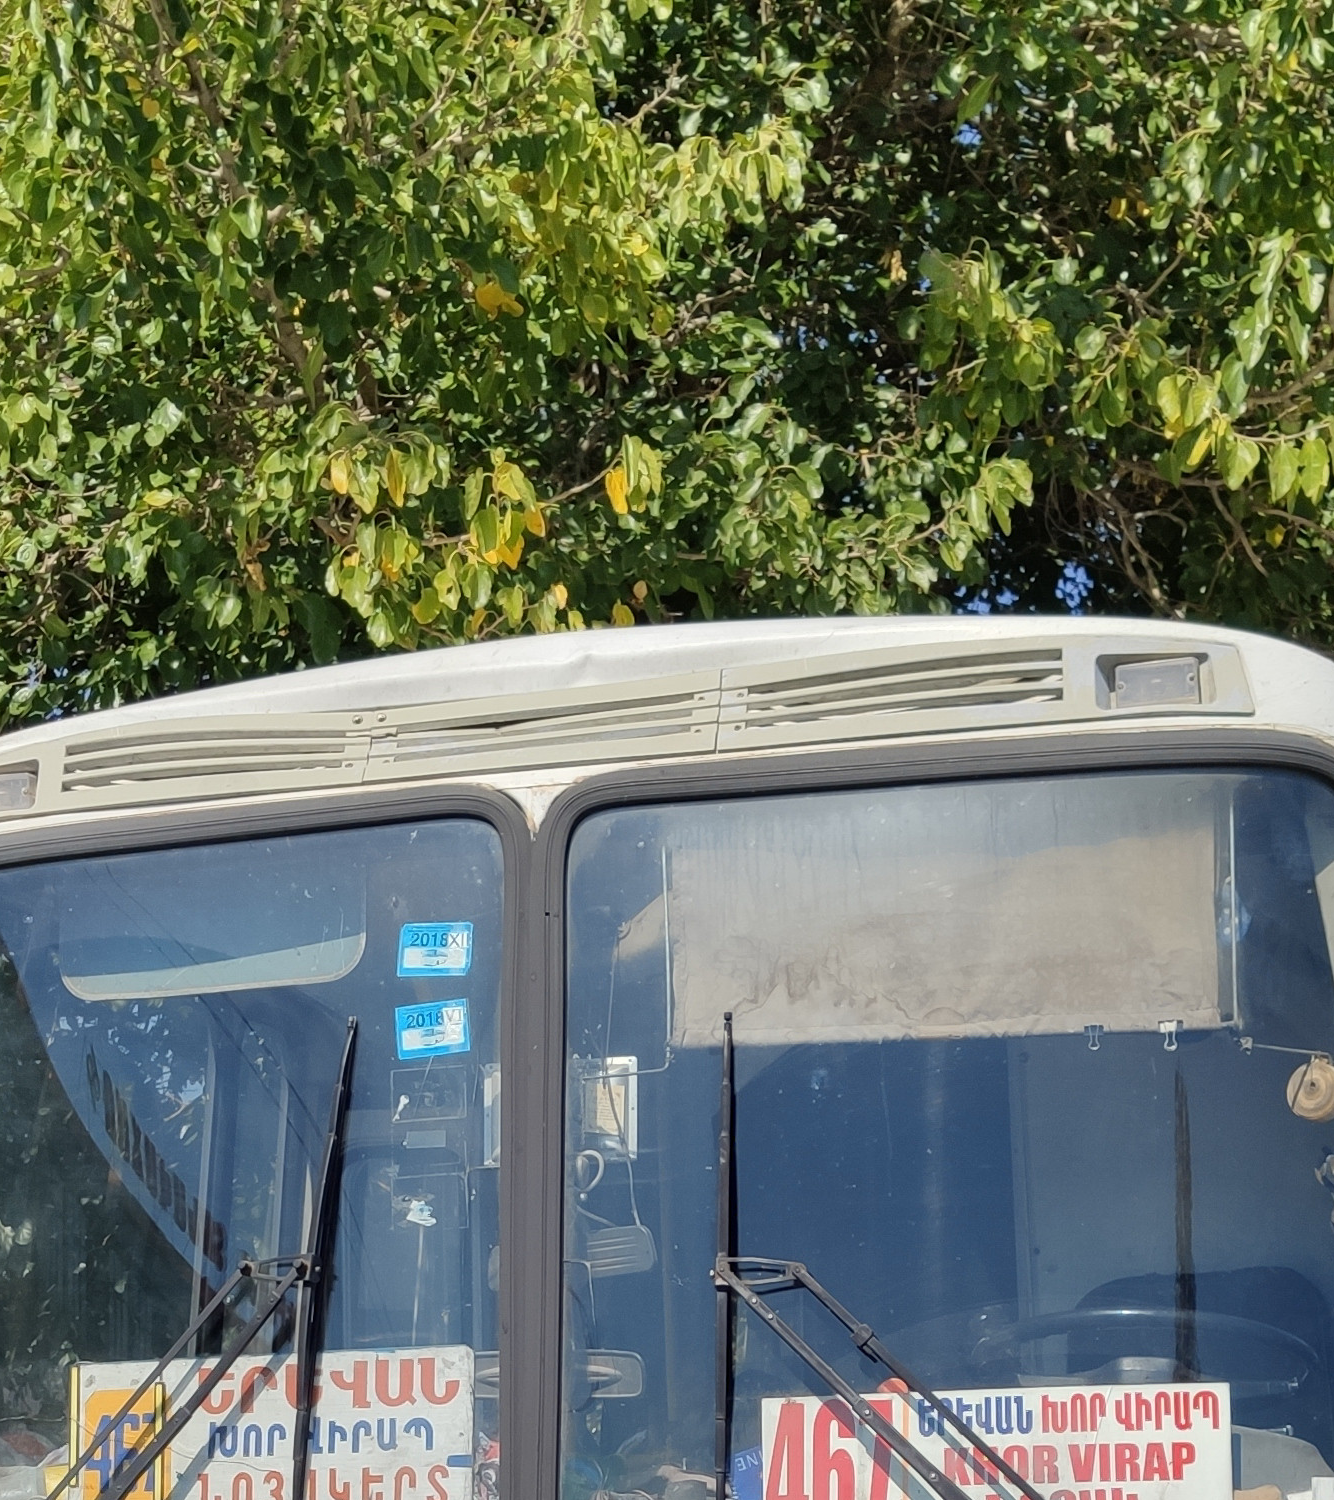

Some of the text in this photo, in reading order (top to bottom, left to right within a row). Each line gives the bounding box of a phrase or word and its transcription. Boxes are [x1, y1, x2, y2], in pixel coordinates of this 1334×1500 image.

[410, 932, 448, 948] 2018
[406, 1010, 444, 1029] 2018
[1041, 1392, 1107, 1434] ԽՈՐ
[1114, 1390, 1220, 1432] ՎԻՐԱՊ
[208, 1422, 287, 1459] ԽՈՐ
[943, 1441, 1196, 1486] KHOR VIRAP
